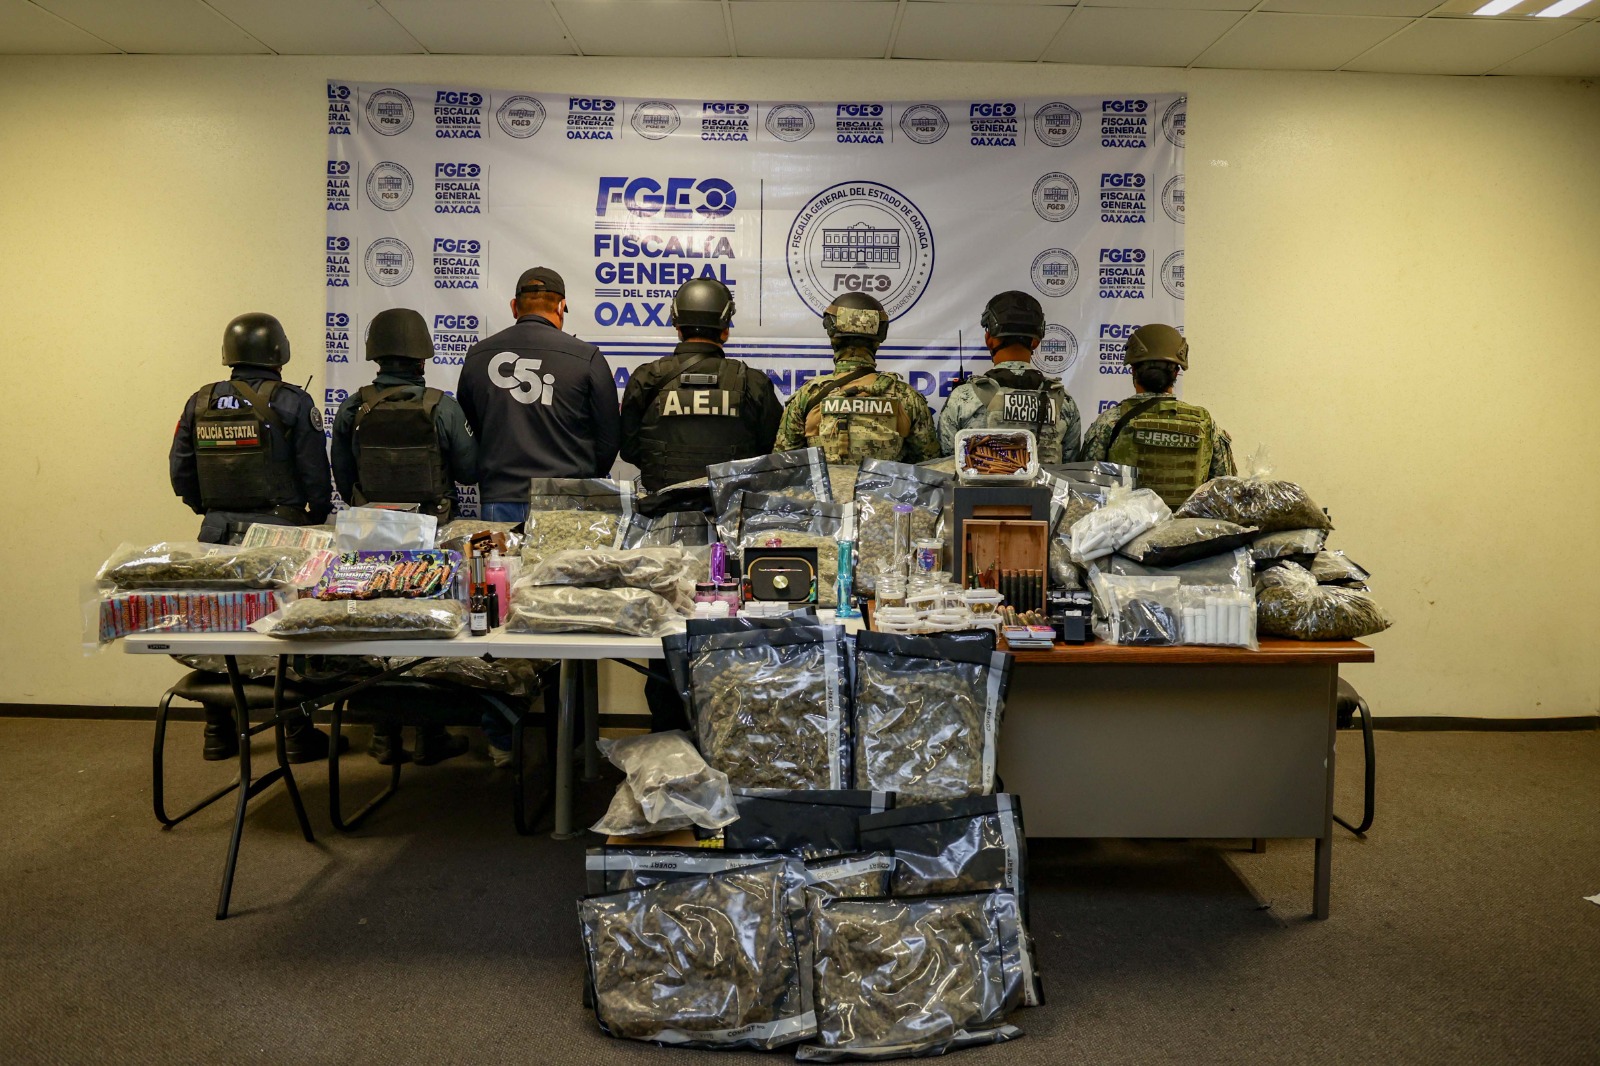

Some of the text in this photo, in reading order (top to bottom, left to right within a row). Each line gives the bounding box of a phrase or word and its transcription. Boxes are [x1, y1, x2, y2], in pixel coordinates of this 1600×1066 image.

[328, 85, 350, 99] EO
[436, 91, 482, 105] FGEO
[329, 104, 350, 112] ALÍA
[569, 98, 615, 111] FGEO
[703, 103, 749, 114] FGEO
[970, 103, 1016, 116] FGEO
[1102, 100, 1147, 112] FGEO
[434, 107, 480, 115] FISCALÍA
[837, 104, 883, 116] FGEO
[1102, 117, 1147, 126] FISCALÍA
[328, 126, 350, 135] ACA
[436, 130, 481, 138] OAXACA
[567, 131, 613, 139] OAXACA
[701, 133, 748, 141] OAXACA
[837, 135, 883, 143] OAXACA
[971, 138, 1016, 146] OAXACA
[1102, 139, 1146, 148] OAXACA
[328, 161, 350, 174] EO
[435, 163, 480, 177] FGEO
[1101, 173, 1145, 187] FGEO
[435, 183, 480, 191] FISCALÍA
[596, 177, 736, 218] FGEO
[1101, 192, 1145, 200] FISCALÍA
[328, 202, 349, 210] ACA
[435, 205, 480, 213] OAXACA
[1101, 201, 1145, 209] GENERAL
[792, 188, 928, 249] FISCALÍA GENERAL DEL ESTADO DE OAXACA
[1101, 214, 1145, 223] OAXACA
[327, 236, 350, 250] EO
[433, 238, 480, 254] FGEO
[594, 234, 735, 258] FISCALÍA
[327, 255, 349, 264] ALÍA
[1100, 249, 1146, 262] FGEO
[433, 258, 480, 267] FISCALÍA
[595, 262, 736, 285] GENERAL
[1100, 268, 1144, 276] FISCALÍA
[435, 280, 478, 289] OAXACA
[833, 274, 891, 291] FGEO
[647, 290, 678, 298] ESTA
[1100, 290, 1144, 298] OAXACA
[802, 285, 918, 316] HONESTI NSPARENCIA
[595, 302, 673, 326] OAX
[326, 313, 349, 326] EO
[434, 315, 479, 329] FGEO
[326, 332, 348, 340] ALÍA
[326, 355, 348, 363] ACA
[433, 356, 465, 365] OAXA
[1100, 366, 1132, 374] OAXAC
[325, 389, 348, 402] EO
[663, 390, 736, 415] A.E.I.
[1009, 394, 1052, 408] GUAR
[824, 400, 893, 414] MARINA
[1098, 400, 1120, 414] FG
[197, 424, 257, 439] POLICÍA ESTATAL
[457, 487, 476, 495] ALÍA
[454, 509, 476, 517] ACA
